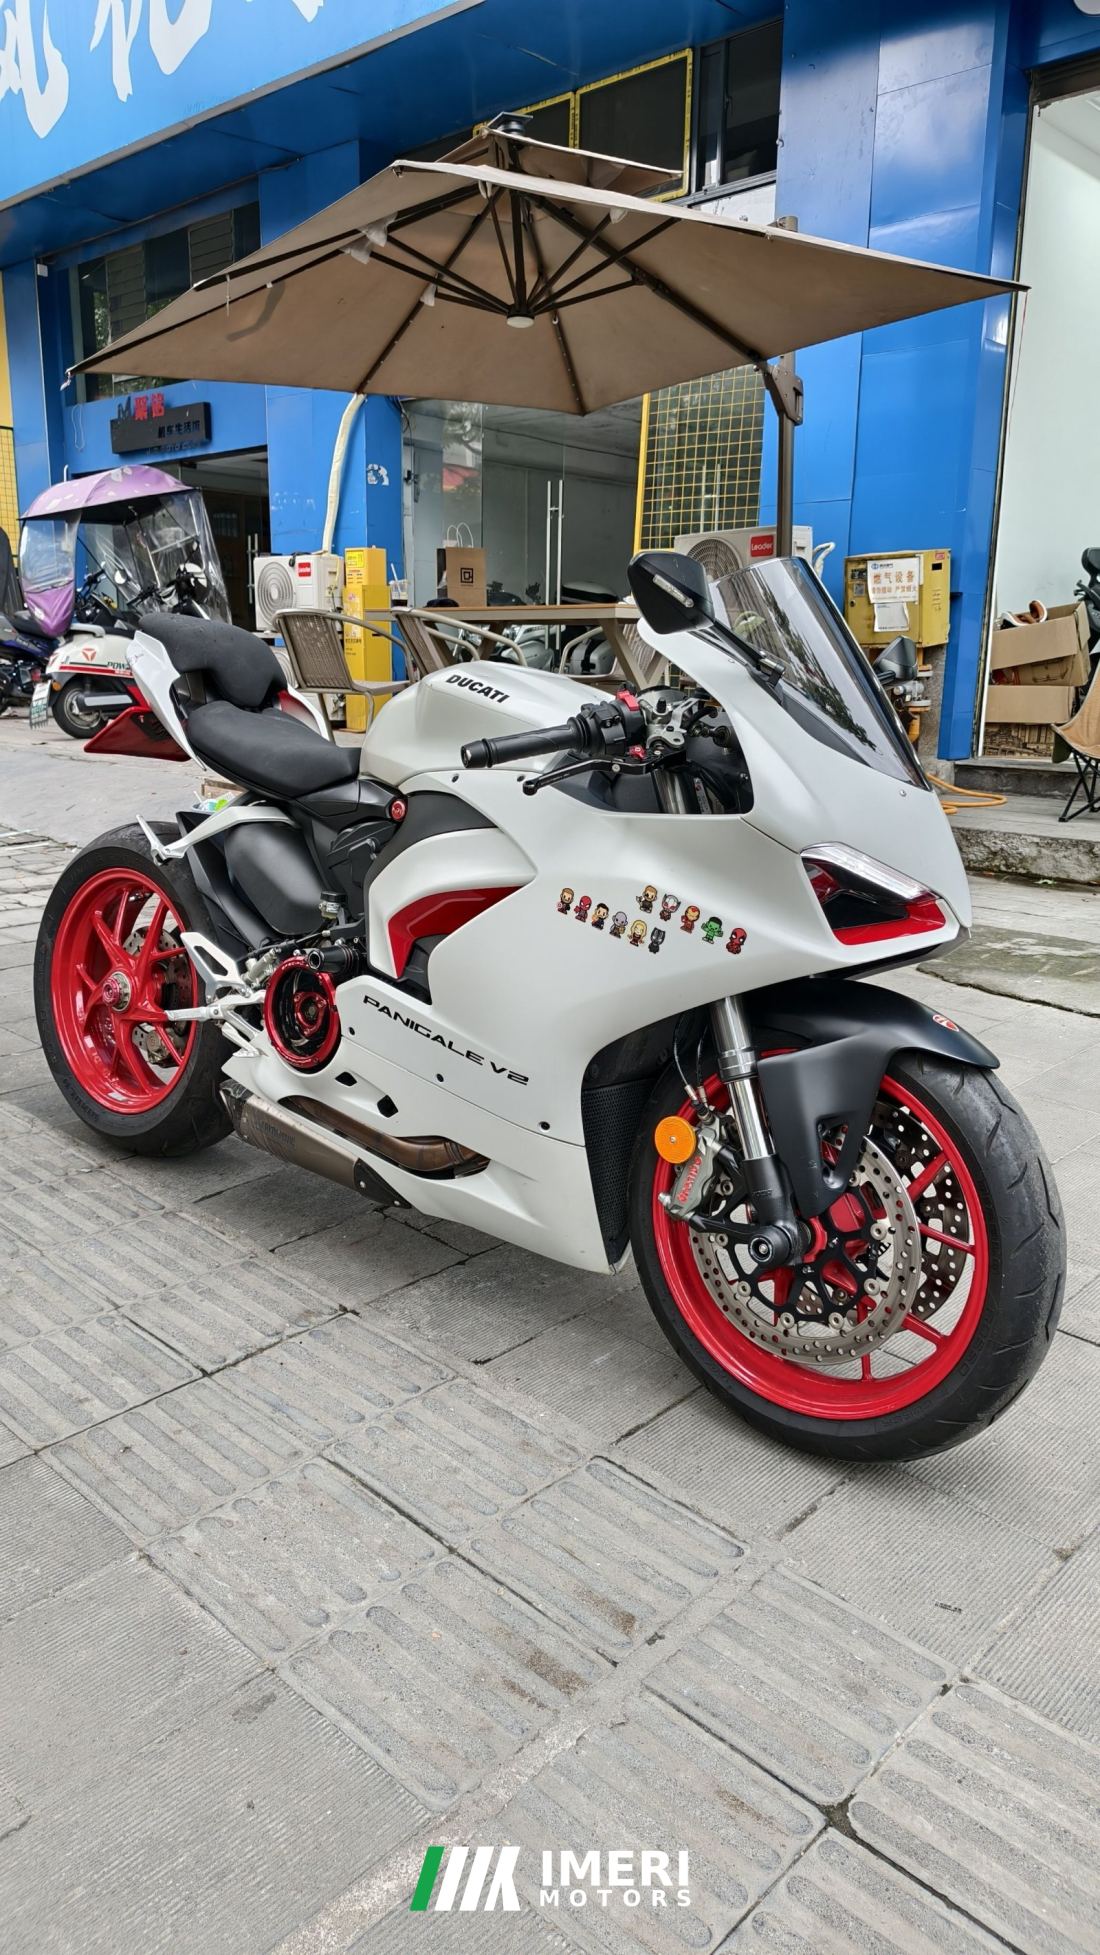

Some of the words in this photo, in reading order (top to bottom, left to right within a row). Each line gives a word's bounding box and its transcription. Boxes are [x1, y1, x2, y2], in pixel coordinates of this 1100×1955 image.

[751, 542, 773, 551] Leader
[873, 571, 914, 584] 燃气设备
[445, 674, 510, 703] DUCATI
[362, 995, 485, 1066] PANIGALE
[489, 1061, 530, 1086] V2
